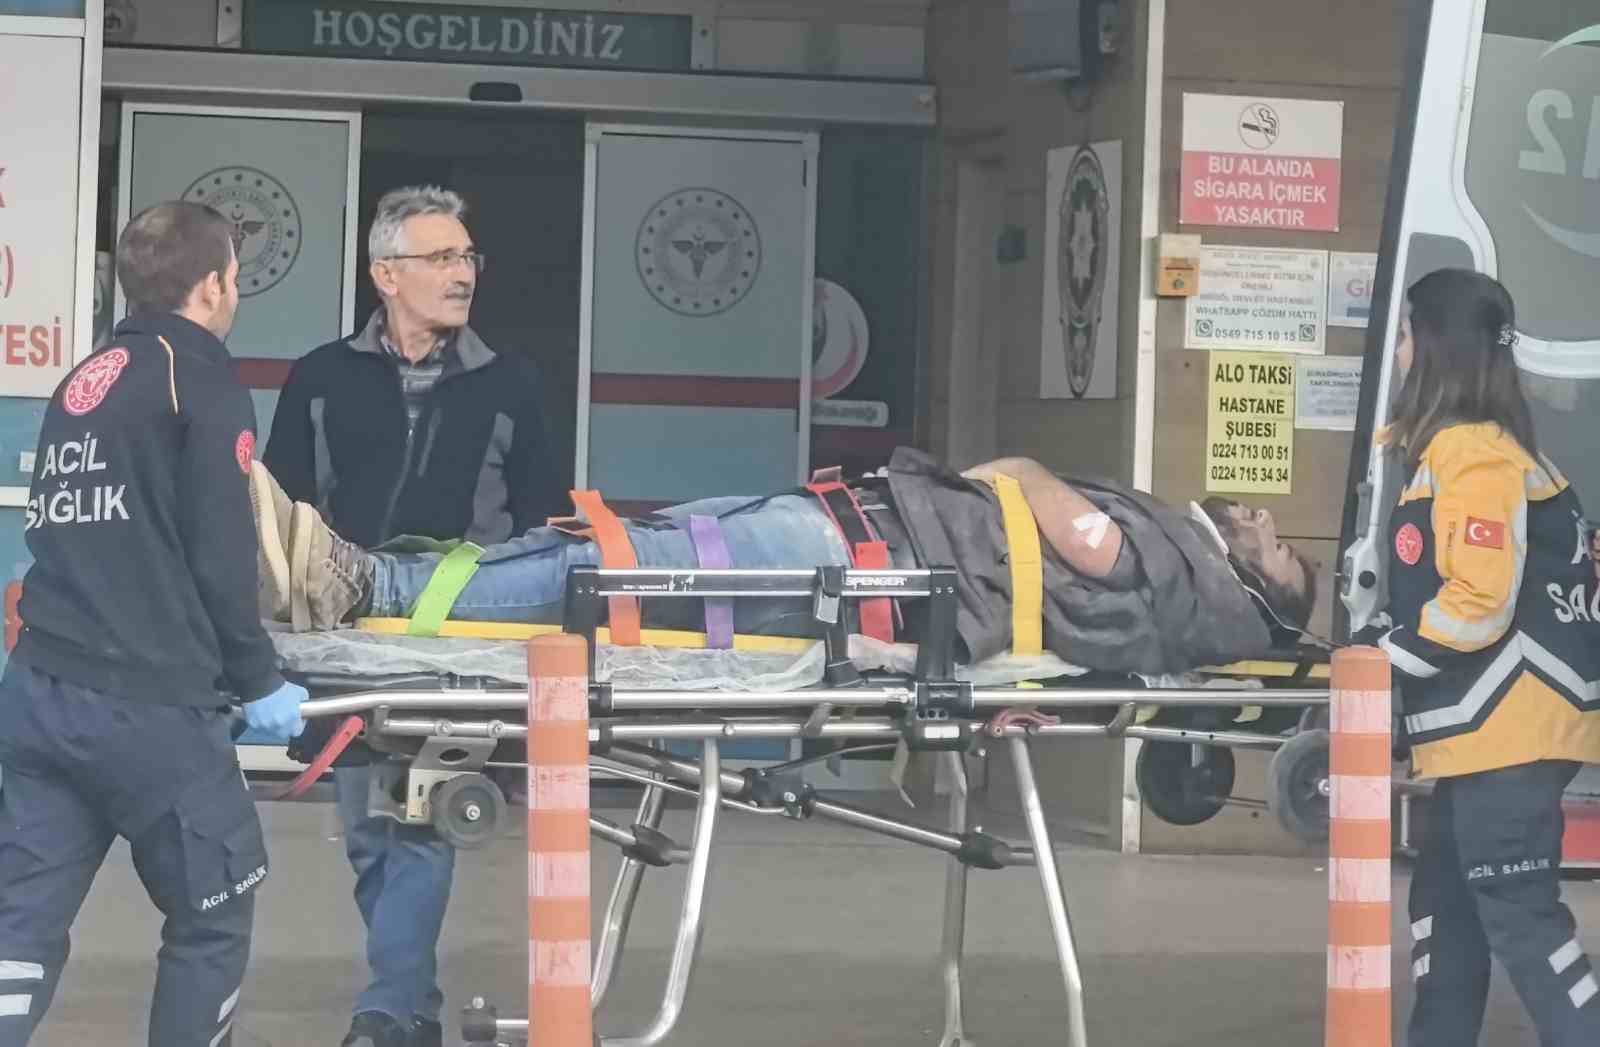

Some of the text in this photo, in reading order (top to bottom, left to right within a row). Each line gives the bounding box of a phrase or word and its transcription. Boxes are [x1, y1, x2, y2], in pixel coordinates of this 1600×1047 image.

[312, 9, 625, 60] HOŞGELDİNİZ
[1208, 155, 1315, 178] BU ALANDA
[1193, 176, 1327, 204] SİGARA İÇMEK
[1215, 205, 1305, 226] YASAKTIR
[1215, 328, 1241, 339] 0549
[1245, 329, 1264, 340] 715
[1267, 330, 1281, 341] 10
[1215, 363, 1245, 382] ALO
[1219, 396, 1285, 414] HASTANE
[40, 431, 107, 480] ACİL
[1212, 443, 1289, 460] 0224 713 00 51
[1211, 466, 1289, 482] 0224 715 34 34
[25, 481, 130, 529] SAĞLIK
